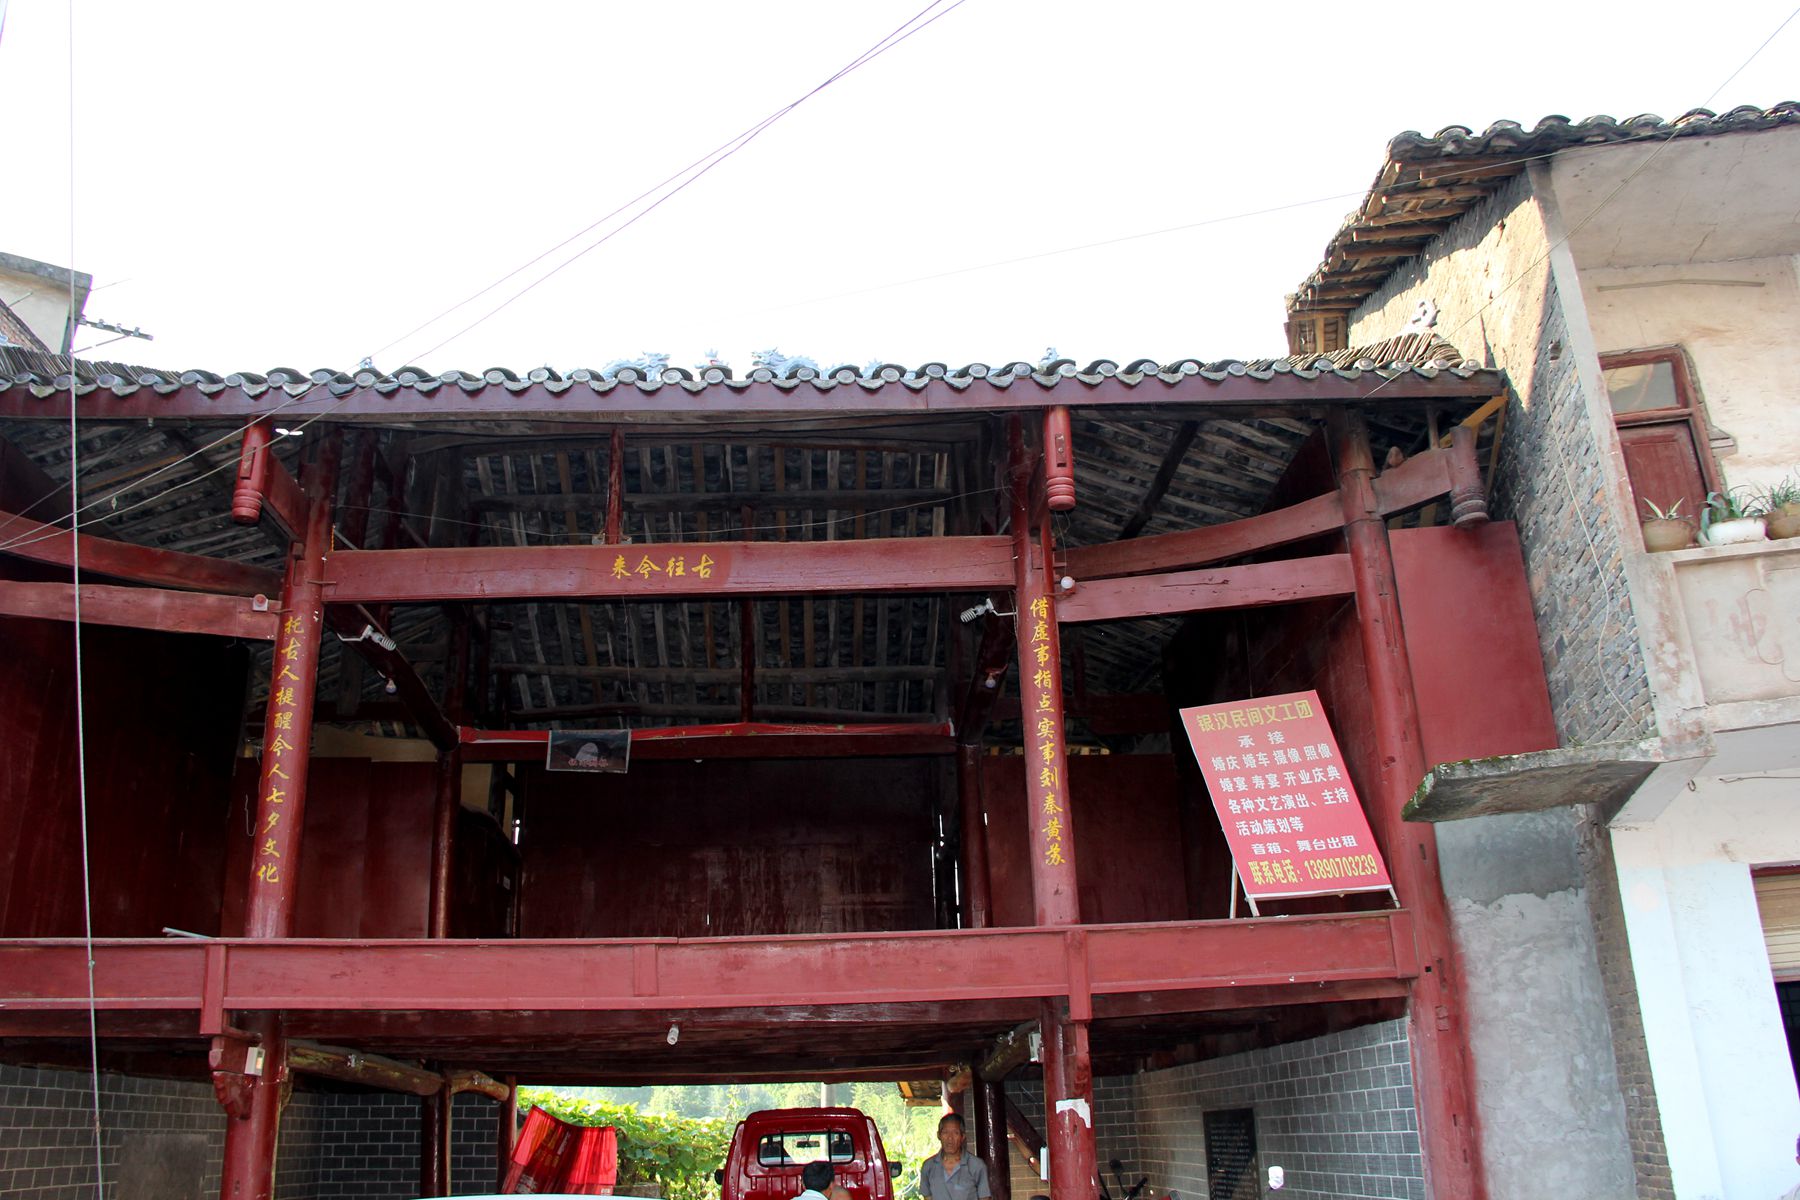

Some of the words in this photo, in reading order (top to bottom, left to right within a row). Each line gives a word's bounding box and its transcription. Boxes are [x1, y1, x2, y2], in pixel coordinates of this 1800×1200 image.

[1196, 700, 1314, 732] 银汉民间文工团
[1211, 756, 1241, 771] 婚庆
[1242, 752, 1271, 768] 婚车
[1273, 748, 1302, 765] 摄像
[1303, 743, 1333, 760] 照像
[1219, 776, 1249, 794] 婚宴
[1252, 773, 1281, 790] 寿宴
[1284, 765, 1342, 787] 开业庆典
[1236, 816, 1305, 837] 活动策划等
[1251, 835, 1359, 855] 音箱、舞台出租
